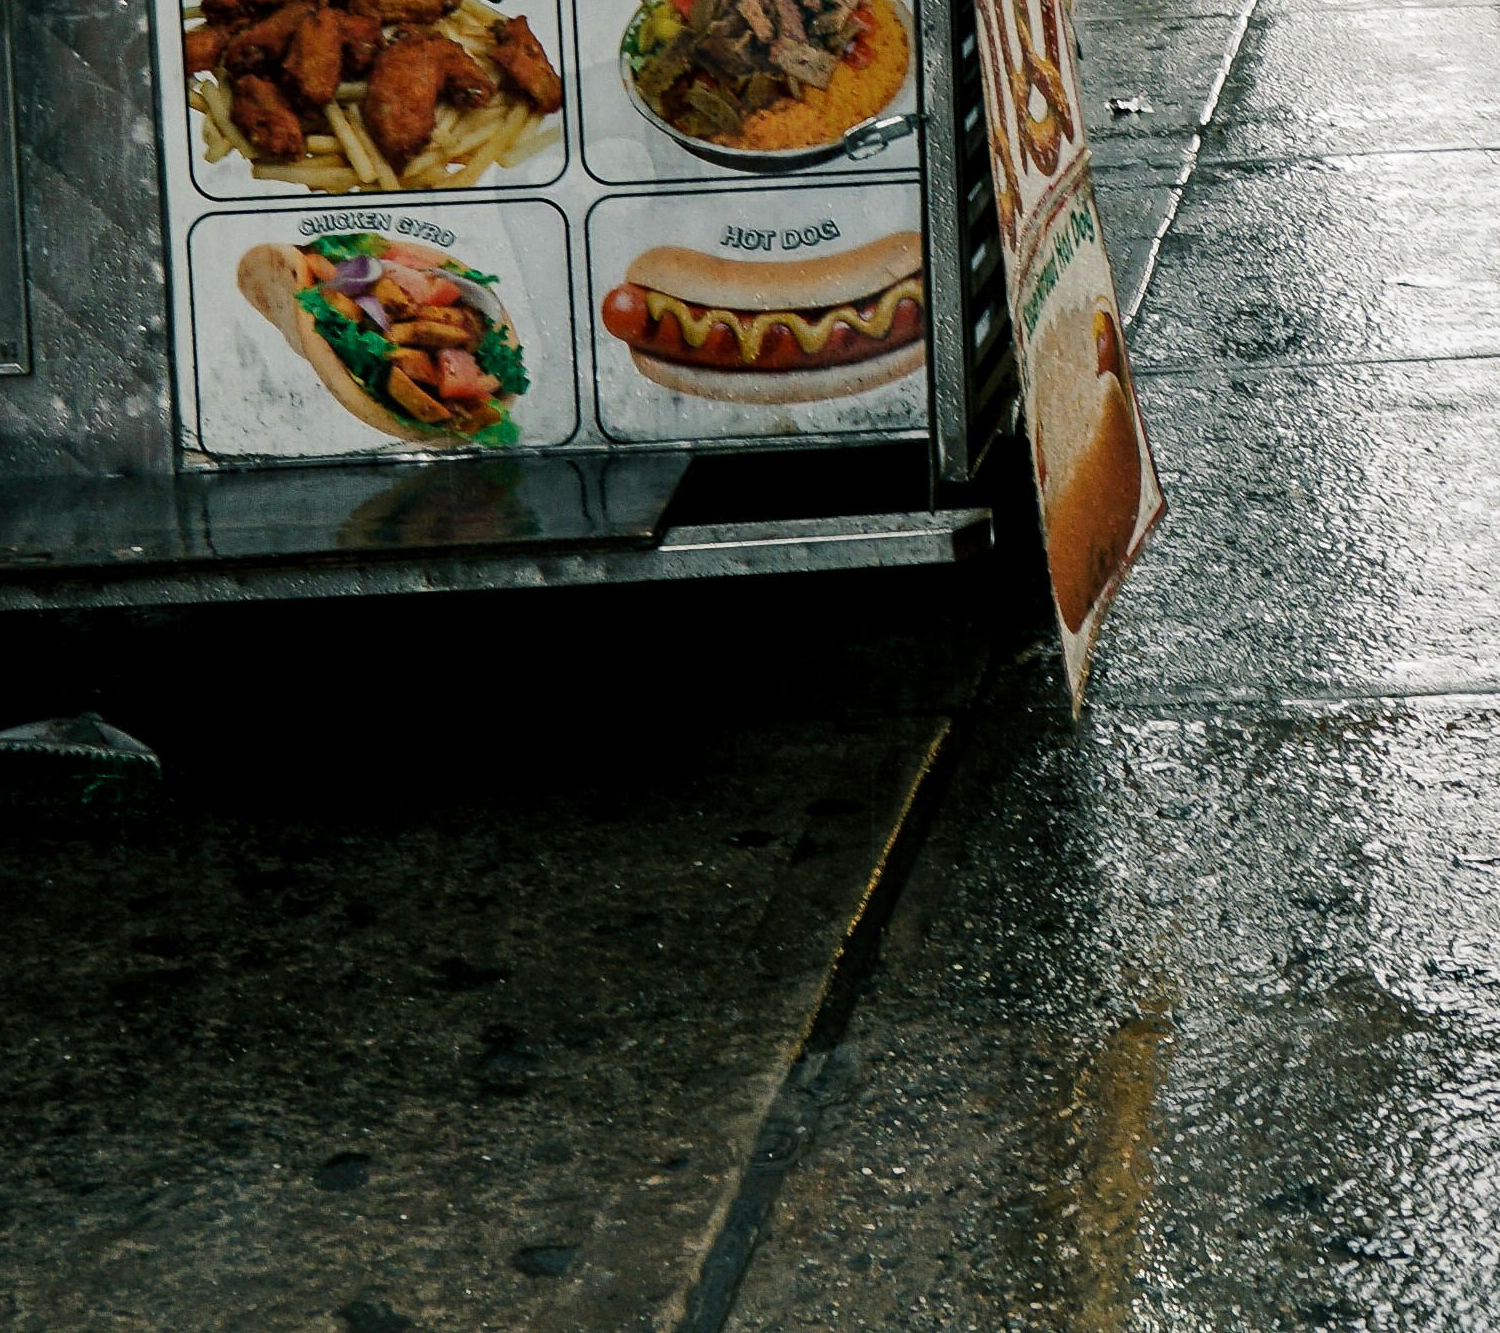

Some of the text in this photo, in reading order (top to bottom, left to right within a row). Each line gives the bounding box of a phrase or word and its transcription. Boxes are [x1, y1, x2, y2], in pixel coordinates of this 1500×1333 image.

[298, 211, 457, 247] CHICKEN GYRO
[720, 218, 841, 250] HOT DOG
